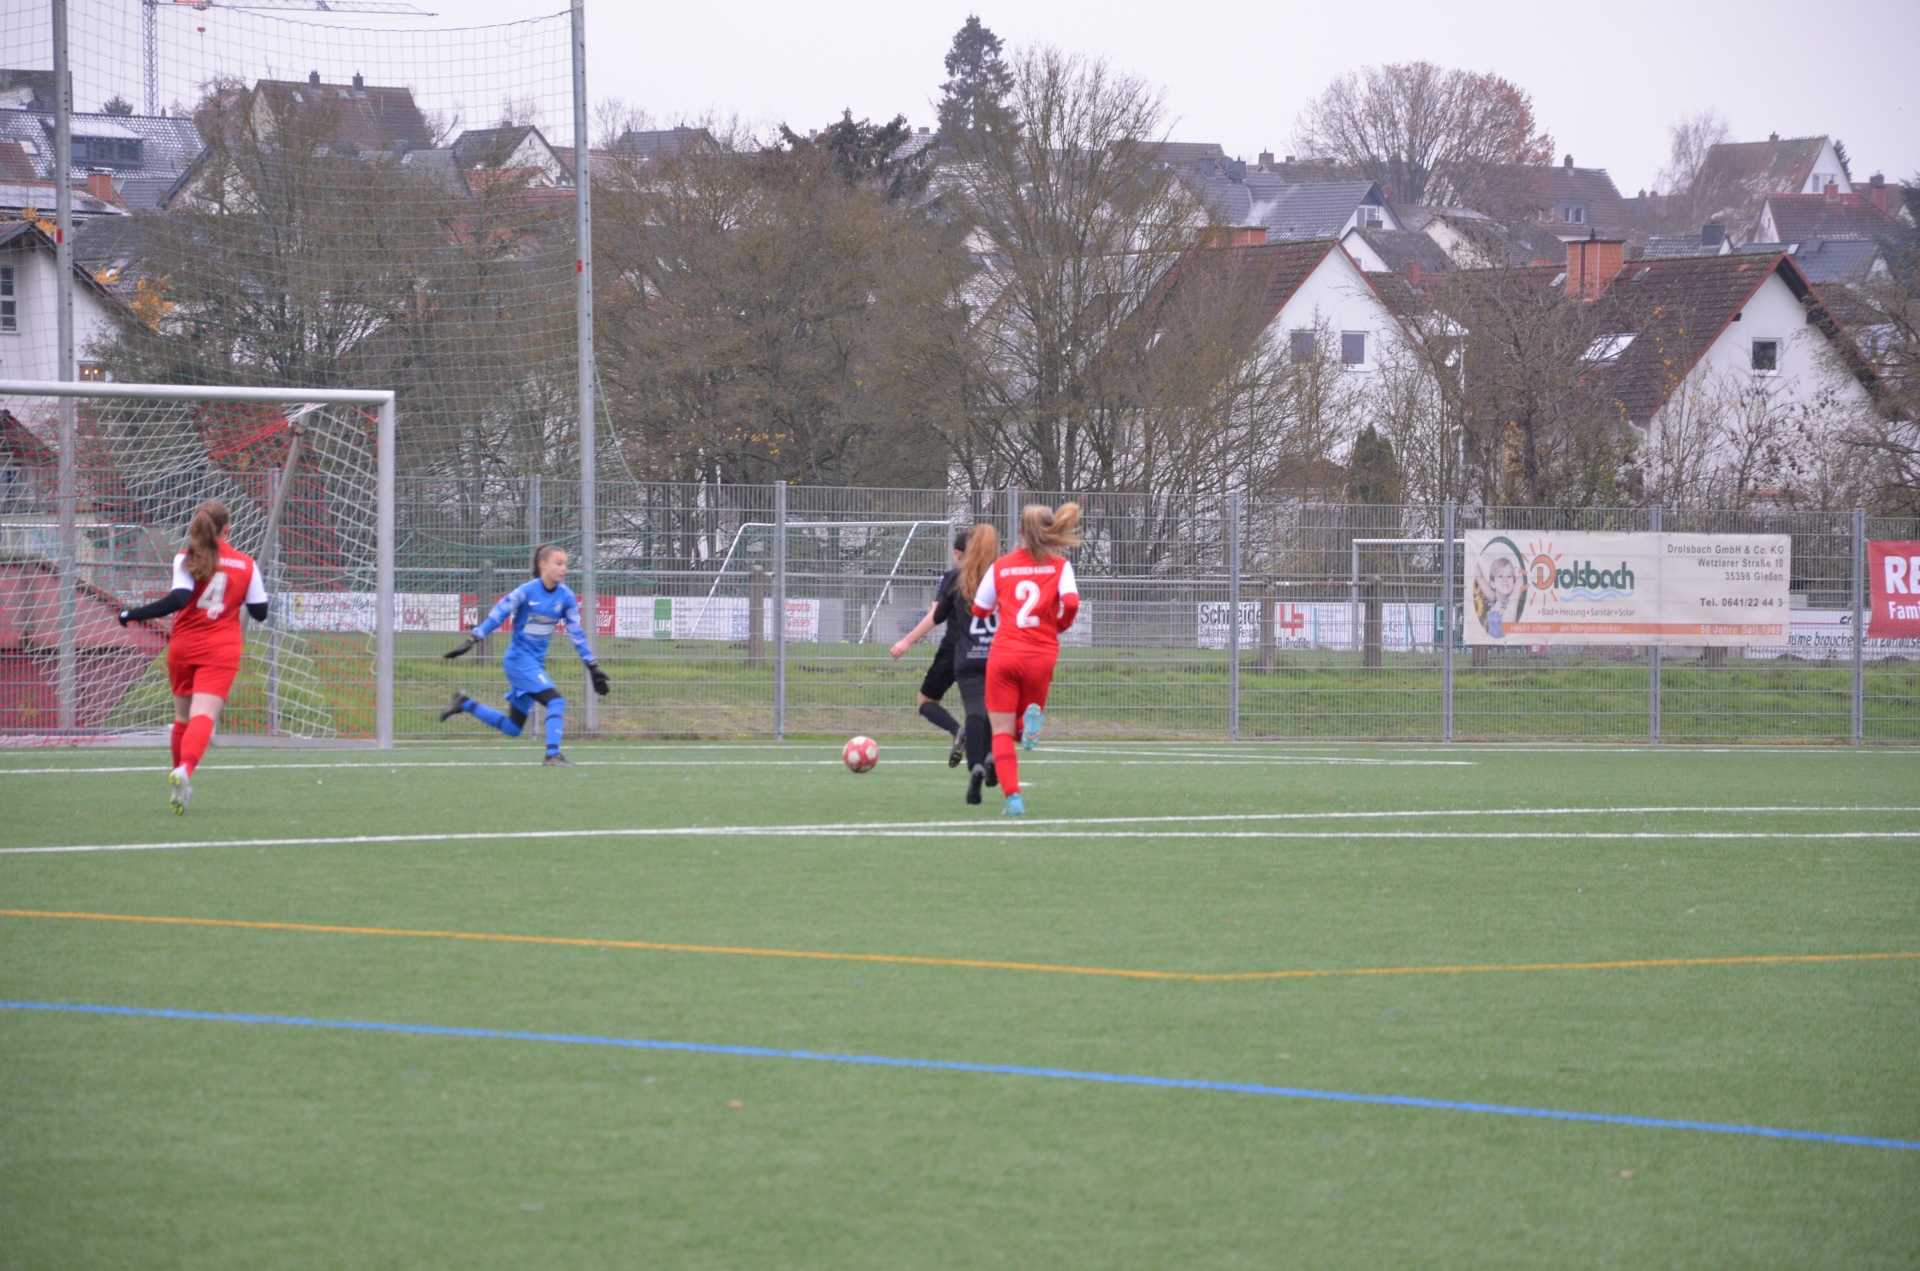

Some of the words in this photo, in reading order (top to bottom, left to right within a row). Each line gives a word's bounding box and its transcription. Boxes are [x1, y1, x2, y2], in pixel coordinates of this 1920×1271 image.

[1668, 544, 1712, 554] Drolsbach
[1715, 545, 1741, 554] GmbH
[1744, 545, 1750, 554] &
[1753, 545, 1767, 555] Co.
[1770, 545, 1784, 555] KG
[1698, 558, 1739, 567] Wetzlarer
[1742, 559, 1771, 568] Straße
[1775, 559, 1784, 568] 10
[1530, 554, 1635, 590] Drolsbach
[1725, 571, 1751, 580] 35398
[1753, 572, 1783, 581] Gießen
[1884, 556, 1920, 594] RE
[197, 571, 228, 619] 4
[1015, 580, 1041, 628] 2
[1700, 597, 1718, 606] Tel.
[1721, 598, 1759, 607] 0641/22
[1762, 598, 1774, 607] 44
[1200, 604, 1262, 624] Schide
[1541, 607, 1555, 616] Bad
[1560, 607, 1586, 618] Heizung
[1590, 608, 1613, 617] Sanitär
[1618, 608, 1635, 617] Solar
[1888, 600, 1920, 619] Fami
[1571, 624, 1598, 633] Morgen
[1700, 625, 1710, 634] 50
[1713, 625, 1739, 634] Jahre
[1741, 625, 1759, 634] Seit
[1761, 625, 1782, 635] 1969
[1814, 632, 1854, 647] brauche
